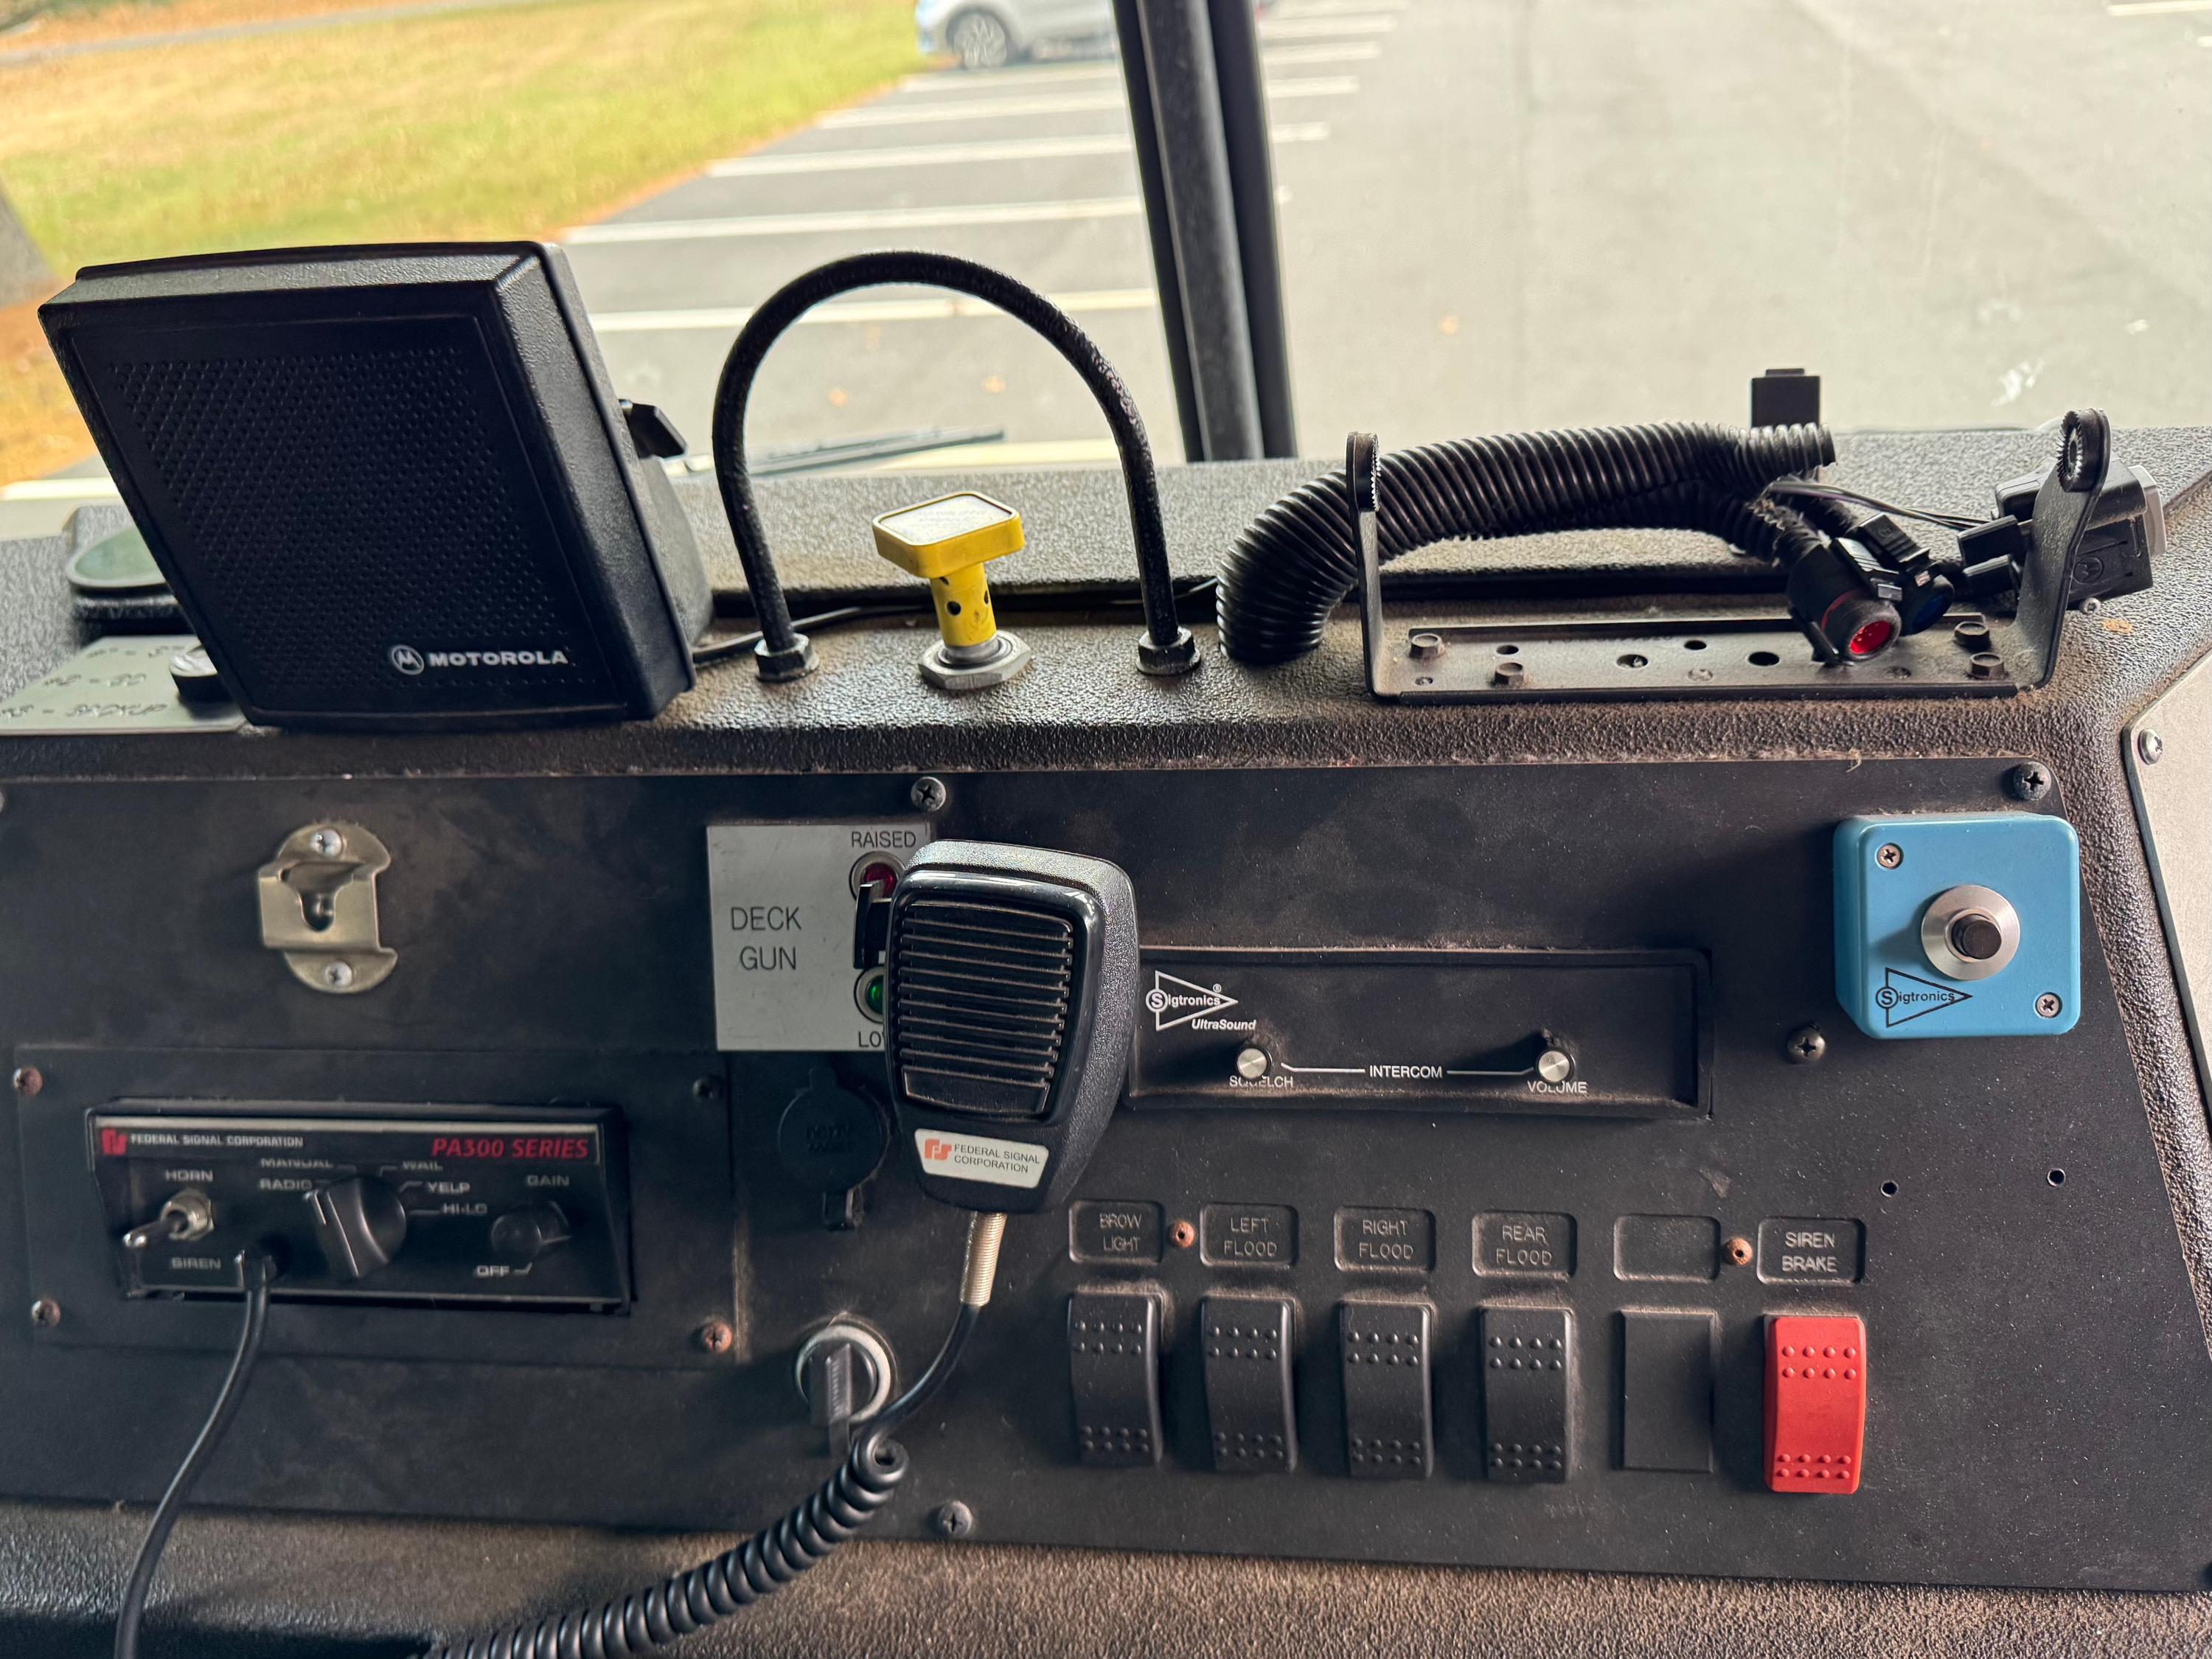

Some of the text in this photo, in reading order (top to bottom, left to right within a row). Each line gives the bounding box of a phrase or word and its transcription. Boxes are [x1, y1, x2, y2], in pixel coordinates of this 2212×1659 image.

[428, 650, 568, 667] MOTOROLA
[852, 831, 917, 848] RAISED
[731, 906, 801, 931] DECK
[740, 946, 797, 971] GUN
[1147, 992, 1221, 1009] Sigtronics
[1879, 989, 1955, 1007] Sigtronics
[1191, 1018, 1257, 1031] UltraSound
[1369, 1065, 1442, 1079] INTERCOM
[1527, 1080, 1587, 1093] VOLUME
[131, 1133, 304, 1147] FEDERAL SIGNAL CORPORATION
[432, 1137, 588, 1159] PA300 SERIES
[954, 1144, 1040, 1165] FEDERAL SIGNAL
[260, 1158, 333, 1169] MANUAL
[403, 1160, 443, 1172] WAIL
[954, 1155, 1029, 1174] CORPORATION
[164, 1169, 214, 1182] HORN
[526, 1175, 570, 1186] GAIN
[427, 1181, 471, 1194] YELP
[1099, 1213, 1142, 1230] BROW
[1230, 1217, 1269, 1234] LEFT
[1363, 1219, 1409, 1236] RIGHT
[1102, 1235, 1140, 1251] LIGHT
[1501, 1225, 1546, 1244] REAR
[1784, 1231, 1835, 1248] SIREN
[1224, 1240, 1278, 1257] FLOOD
[1359, 1242, 1414, 1260] FLOOD
[1495, 1248, 1553, 1266] FLOOD
[170, 1256, 221, 1270] SIREN
[475, 1265, 510, 1278] OFF
[1781, 1256, 1837, 1273] BRAKE
